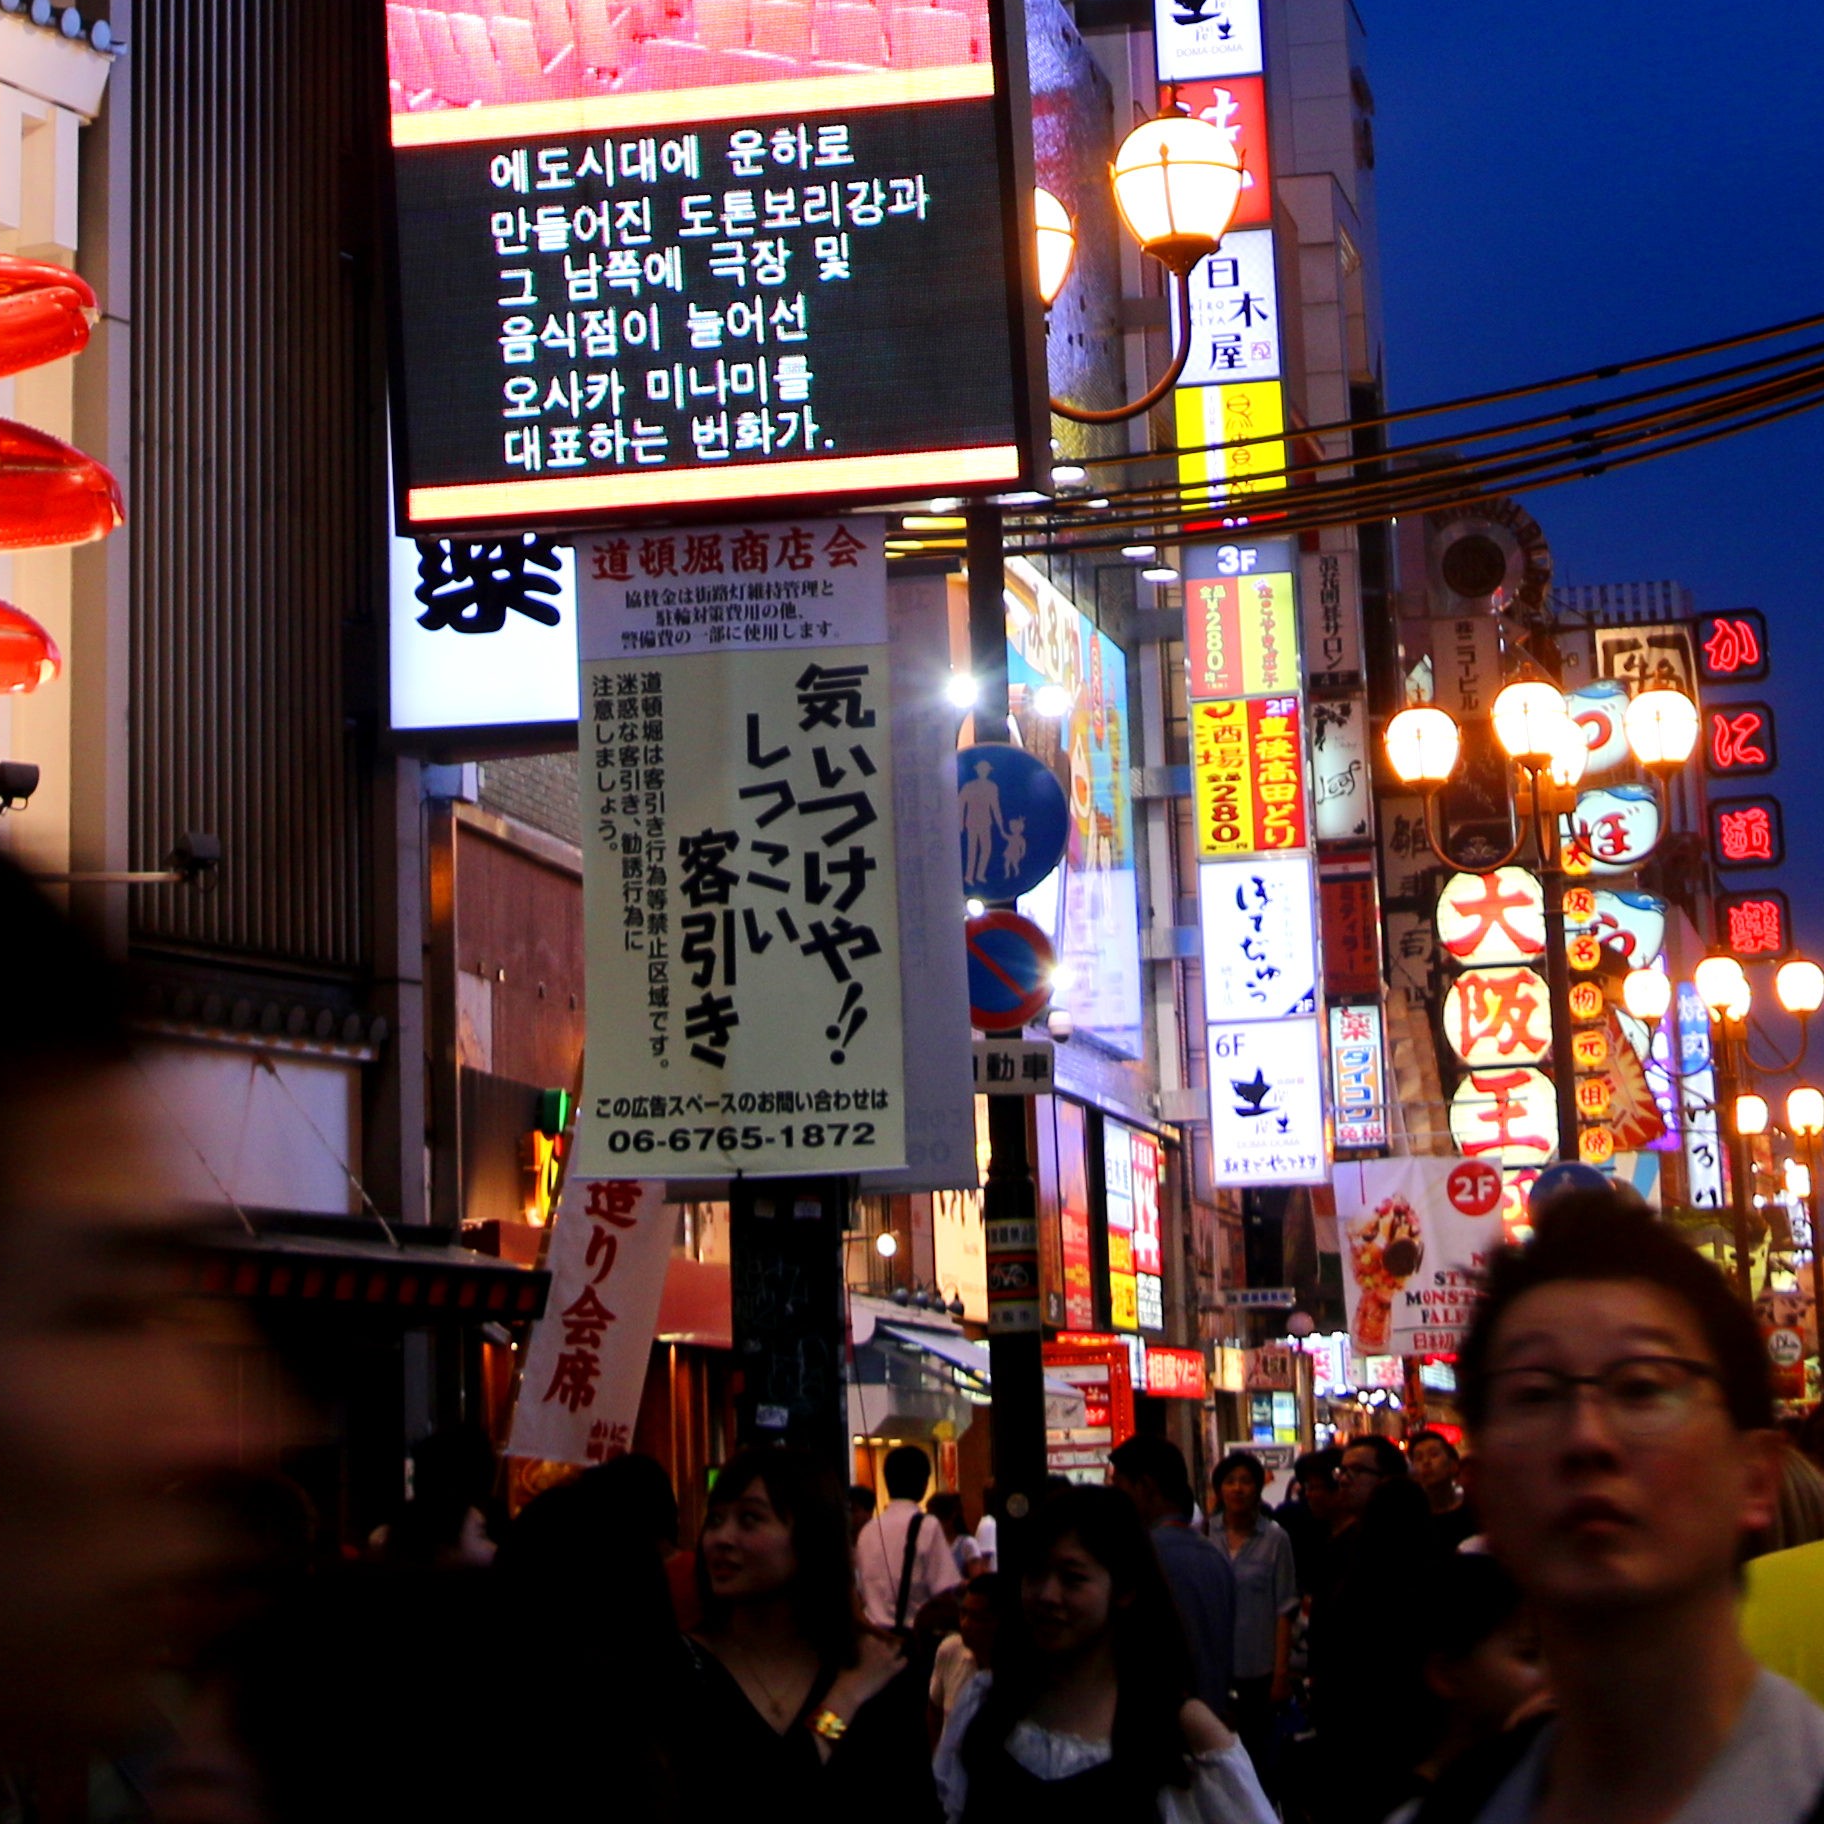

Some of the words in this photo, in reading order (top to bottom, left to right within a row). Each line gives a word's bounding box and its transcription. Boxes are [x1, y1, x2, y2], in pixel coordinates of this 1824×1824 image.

[489, 137, 699, 194] 에도시대에
[726, 123, 856, 173] 운하로
[489, 196, 653, 256] 만들어진
[677, 175, 930, 239] 도톤보리강과
[497, 267, 537, 307] 그
[563, 245, 683, 302] 남쪽에
[708, 238, 791, 289] 극장
[813, 233, 852, 280] 및
[497, 303, 661, 364] 음식점이
[686, 292, 809, 349] 늘어선
[500, 368, 624, 419] 오사카
[646, 354, 813, 410] 미나미를
[504, 415, 668, 472] 대표하는
[691, 406, 835, 461] 번화가.
[591, 522, 868, 582] 道頓堀商店会
[1216, 544, 1258, 574] 3F
[1265, 698, 1295, 716] 2F
[592, 675, 621, 853] 注意しましょう。
[1195, 724, 1247, 769] 酒場
[1211, 784, 1241, 843] 280
[1255, 715, 1297, 848] 豊後高田どり
[1704, 617, 1781, 954] かに道楽
[639, 671, 670, 1069] 道頓堀は客引き行為等禁止区域です。
[678, 827, 741, 1069] 客引き
[973, 1051, 1049, 1082] 動車
[1215, 1032, 1246, 1059] 6F
[595, 1088, 888, 1120] この広告スペースのお問い合わせは
[607, 1123, 876, 1154] 06-6765-1872
[1454, 1174, 1496, 1203] 2F
[542, 1178, 643, 1413] 造り会席
